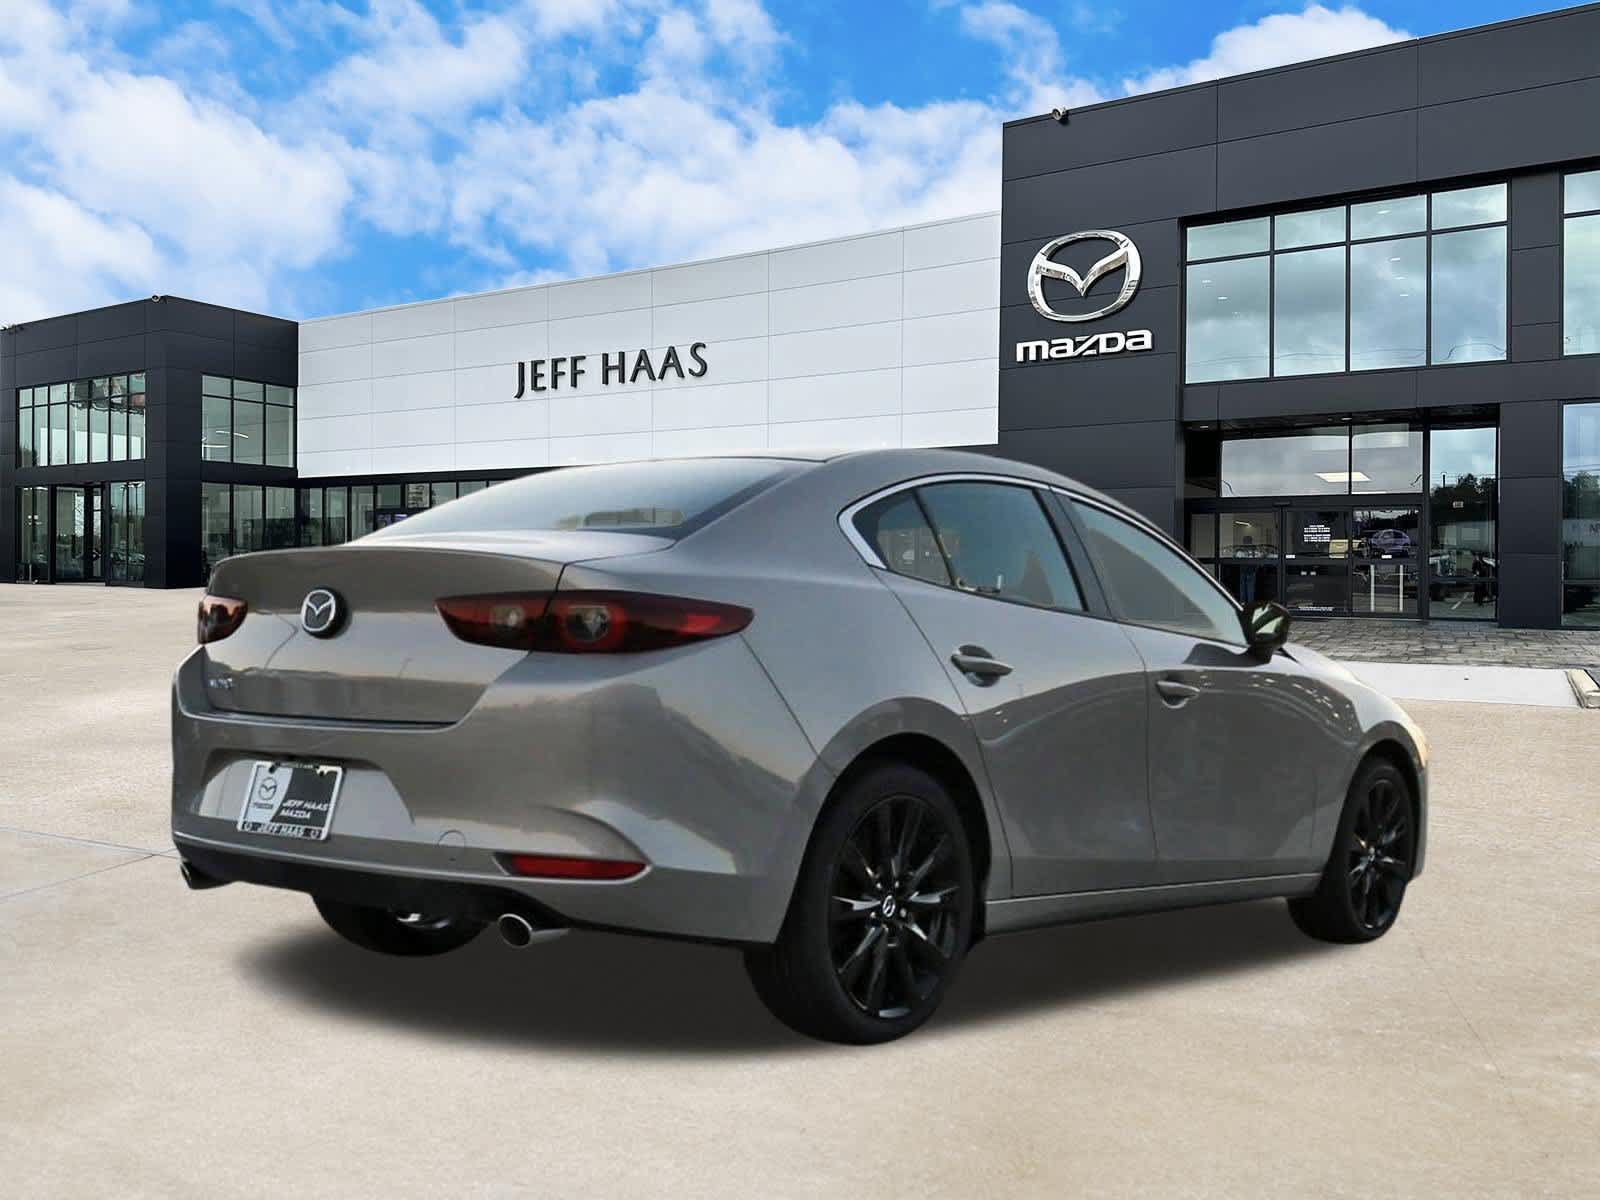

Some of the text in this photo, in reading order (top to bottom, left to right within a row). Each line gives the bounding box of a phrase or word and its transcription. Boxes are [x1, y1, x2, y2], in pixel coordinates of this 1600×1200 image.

[514, 342, 708, 399] JEFF HAAS
[303, 800, 328, 811] HAAS
